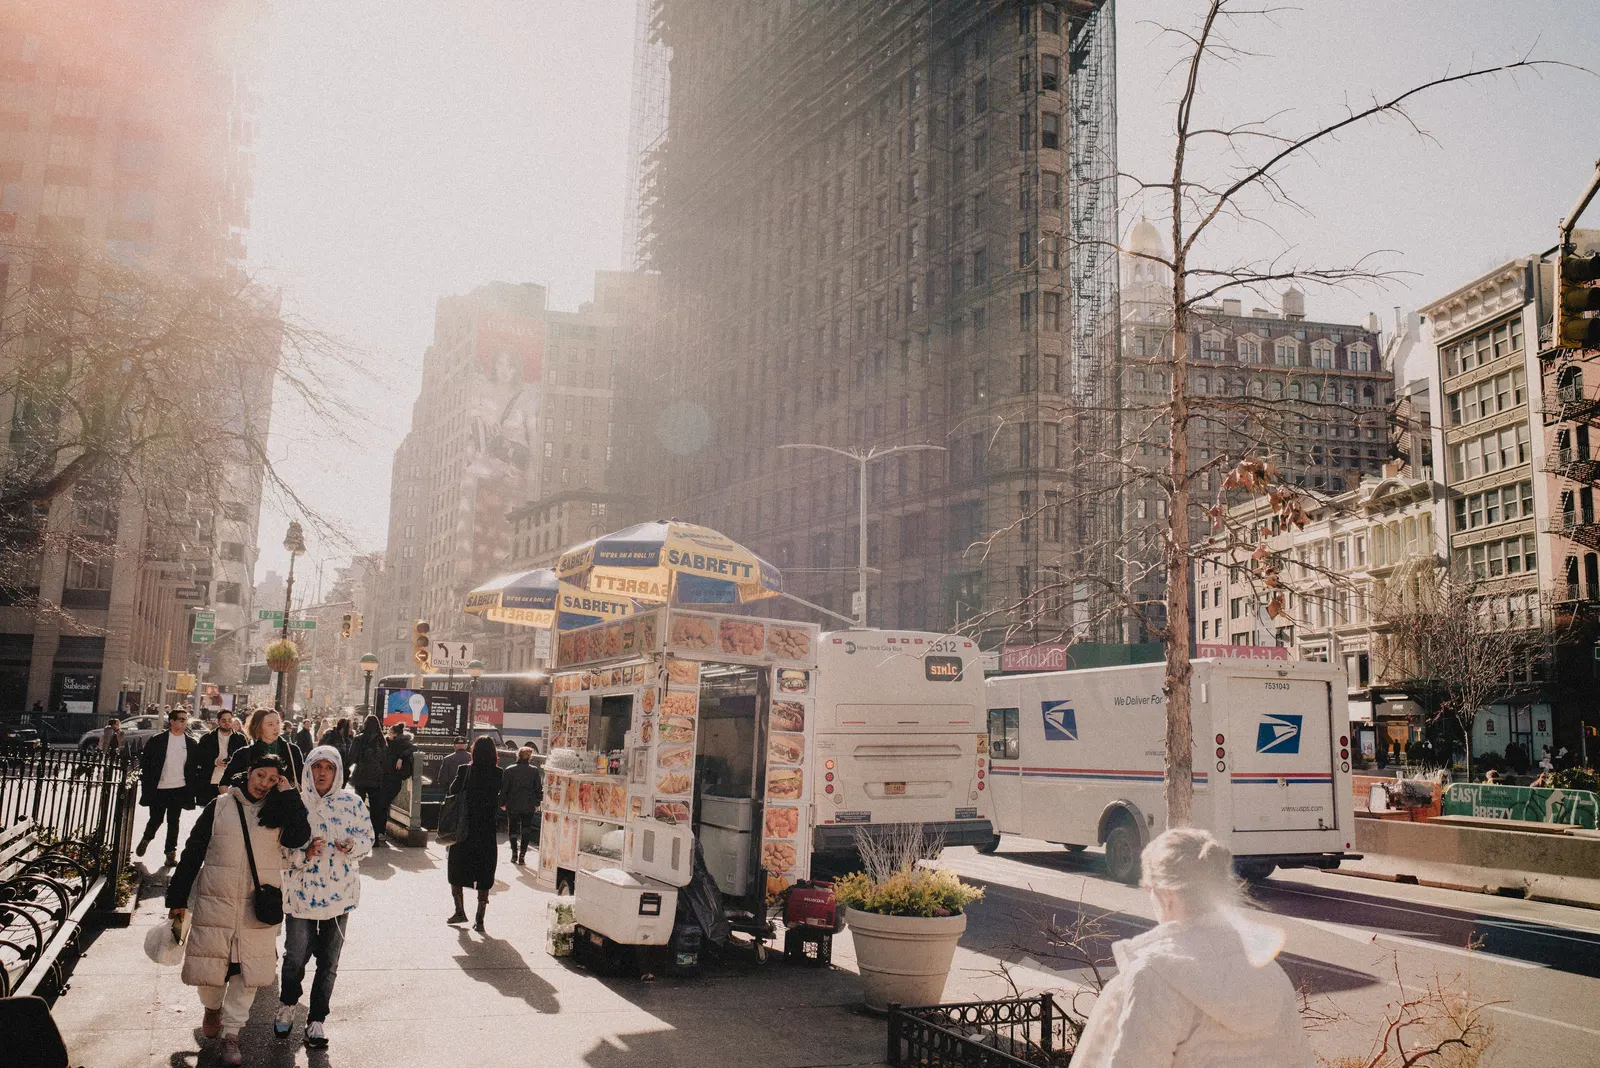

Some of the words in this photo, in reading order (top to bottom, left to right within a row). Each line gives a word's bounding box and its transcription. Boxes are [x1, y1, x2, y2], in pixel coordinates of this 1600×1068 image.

[668, 549, 754, 578] SABRETT
[466, 592, 499, 607] SABRETT
[563, 595, 628, 616] SABRETT
[928, 640, 957, 653] 2512
[475, 698, 498, 712] EGAL
[1114, 696, 1124, 705] We
[1126, 696, 1150, 705] Deliver
[1150, 695, 1163, 704] For
[1450, 788, 1478, 805] EASY
[1472, 806, 1514, 820] BREEZY
